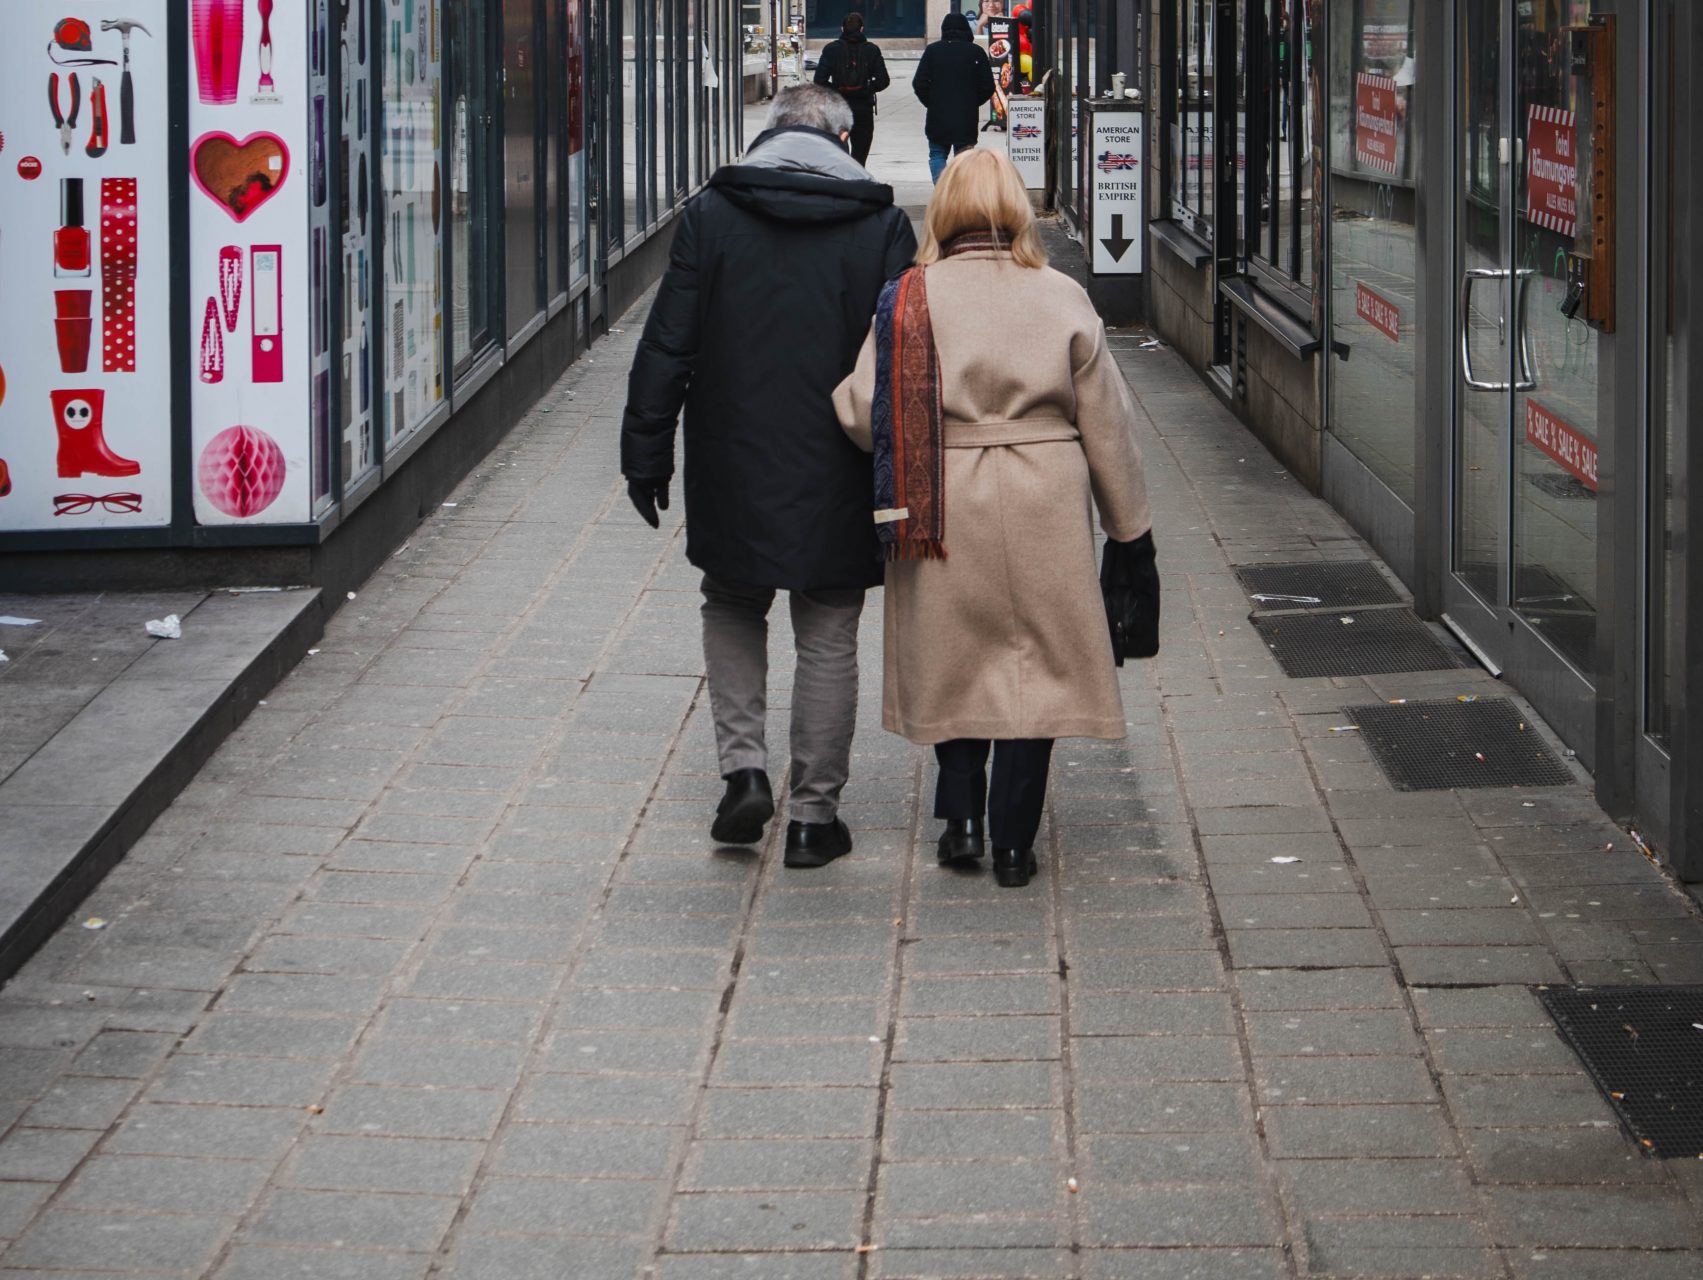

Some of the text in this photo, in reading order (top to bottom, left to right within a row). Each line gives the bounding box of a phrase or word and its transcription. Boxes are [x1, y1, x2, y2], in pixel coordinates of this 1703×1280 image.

[1555, 129, 1570, 157] Total
[1532, 148, 1576, 193] Räumungsve
[1098, 182, 1137, 190] BRITISH
[1099, 192, 1137, 201] EMPIRE
[1535, 411, 1549, 446] SALE
[1558, 428, 1573, 464] SALE
[1582, 445, 1598, 482] SALE
